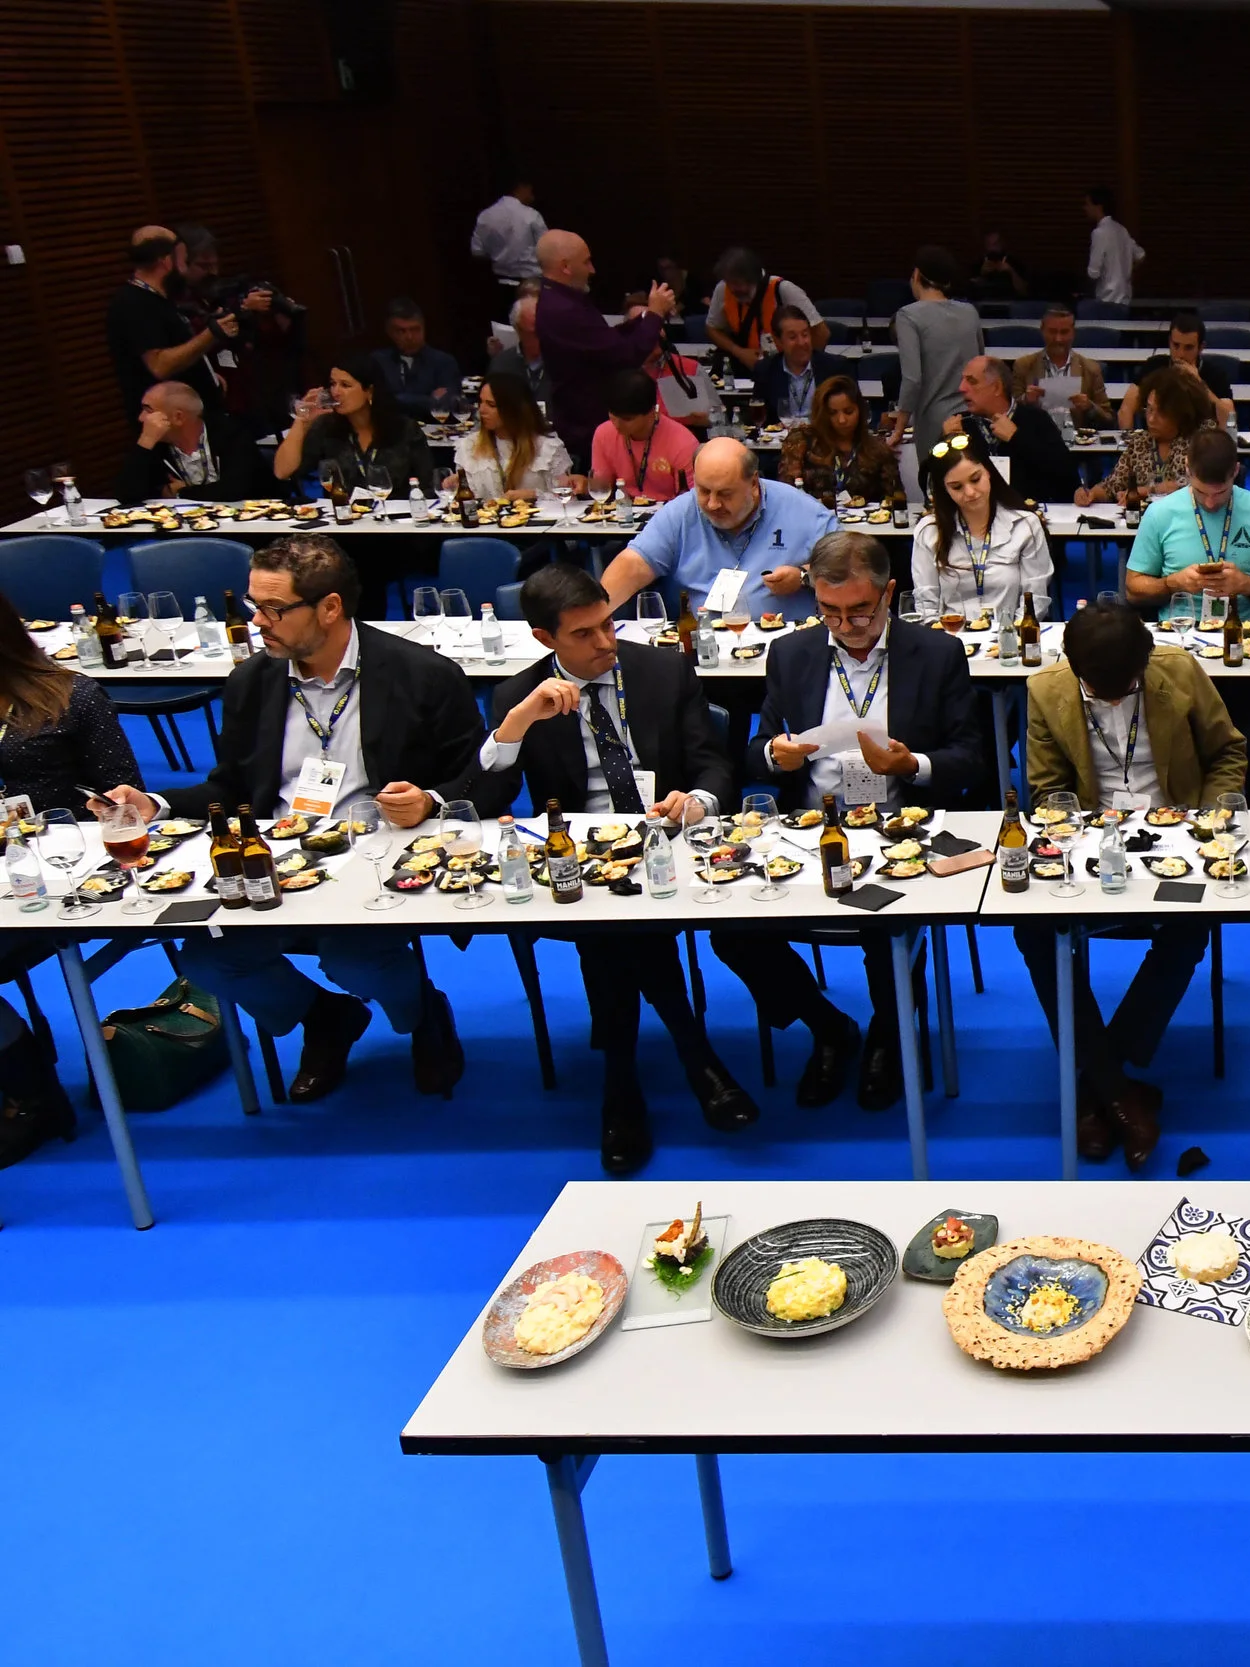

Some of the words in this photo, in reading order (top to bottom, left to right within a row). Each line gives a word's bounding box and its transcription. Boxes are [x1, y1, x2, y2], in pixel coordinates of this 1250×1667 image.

[772, 528, 785, 547] 1
[616, 669, 624, 691] makro
[839, 673, 850, 694] makro
[869, 672, 879, 694] makro
[333, 694, 349, 715] makro
[556, 877, 581, 889] MANILA
[1003, 870, 1026, 878] MANILA
